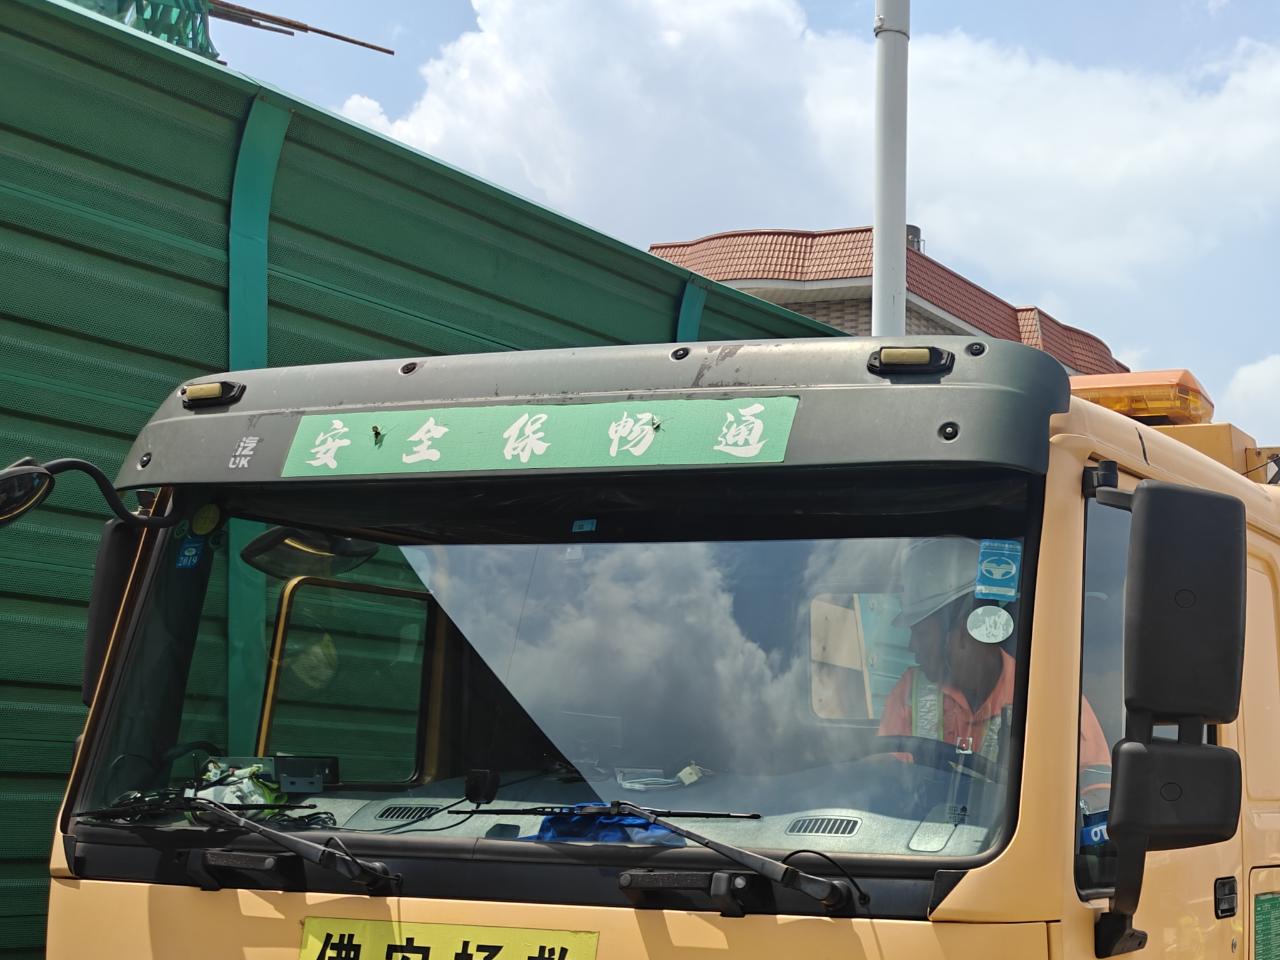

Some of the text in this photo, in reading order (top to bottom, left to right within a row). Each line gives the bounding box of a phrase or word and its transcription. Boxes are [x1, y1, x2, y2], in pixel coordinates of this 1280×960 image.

[305, 403, 771, 468] 安全保畅通
